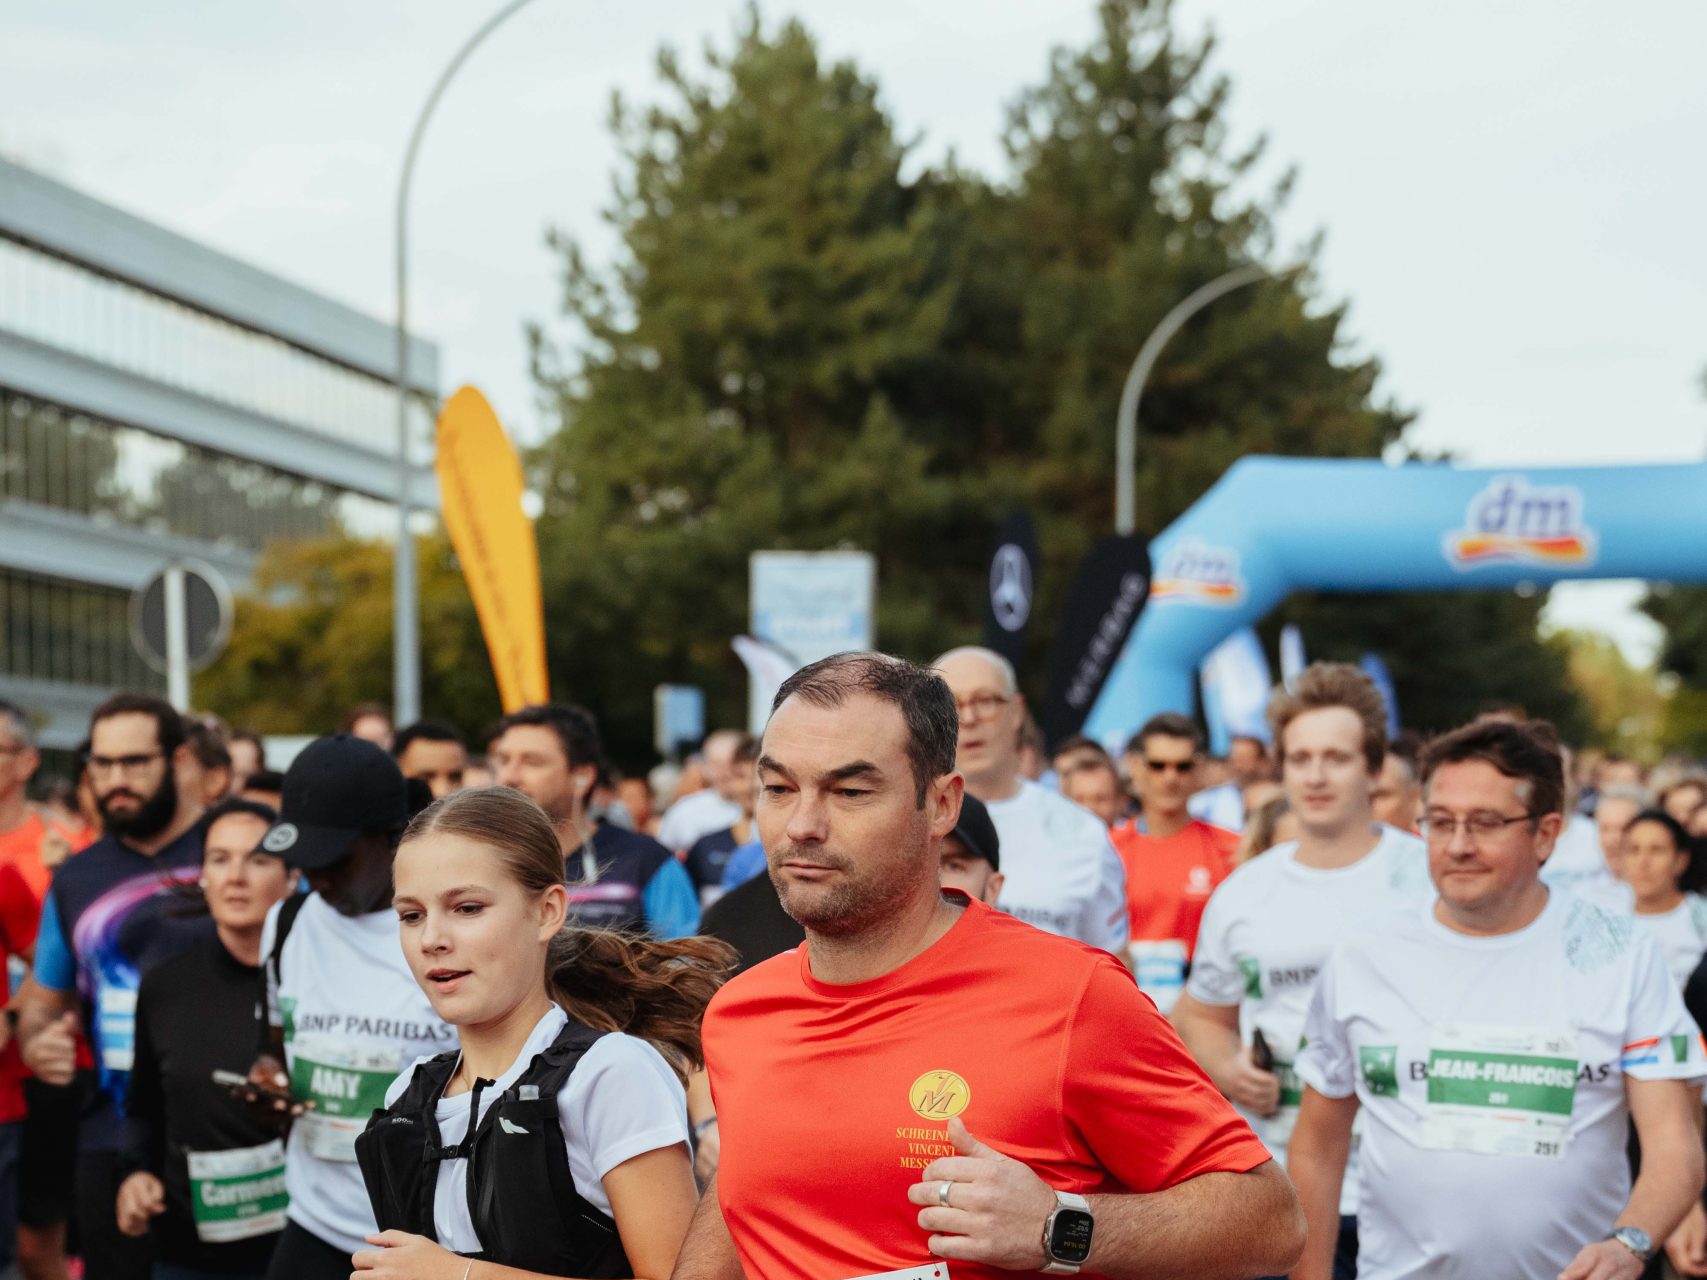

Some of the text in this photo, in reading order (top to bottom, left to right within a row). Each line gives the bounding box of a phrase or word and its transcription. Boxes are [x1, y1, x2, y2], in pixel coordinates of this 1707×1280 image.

[1478, 482, 1572, 537] dm
[346, 1016, 452, 1041] PARIBAS
[311, 1066, 361, 1099] AMY
[908, 1143, 956, 1157] VINCENT
